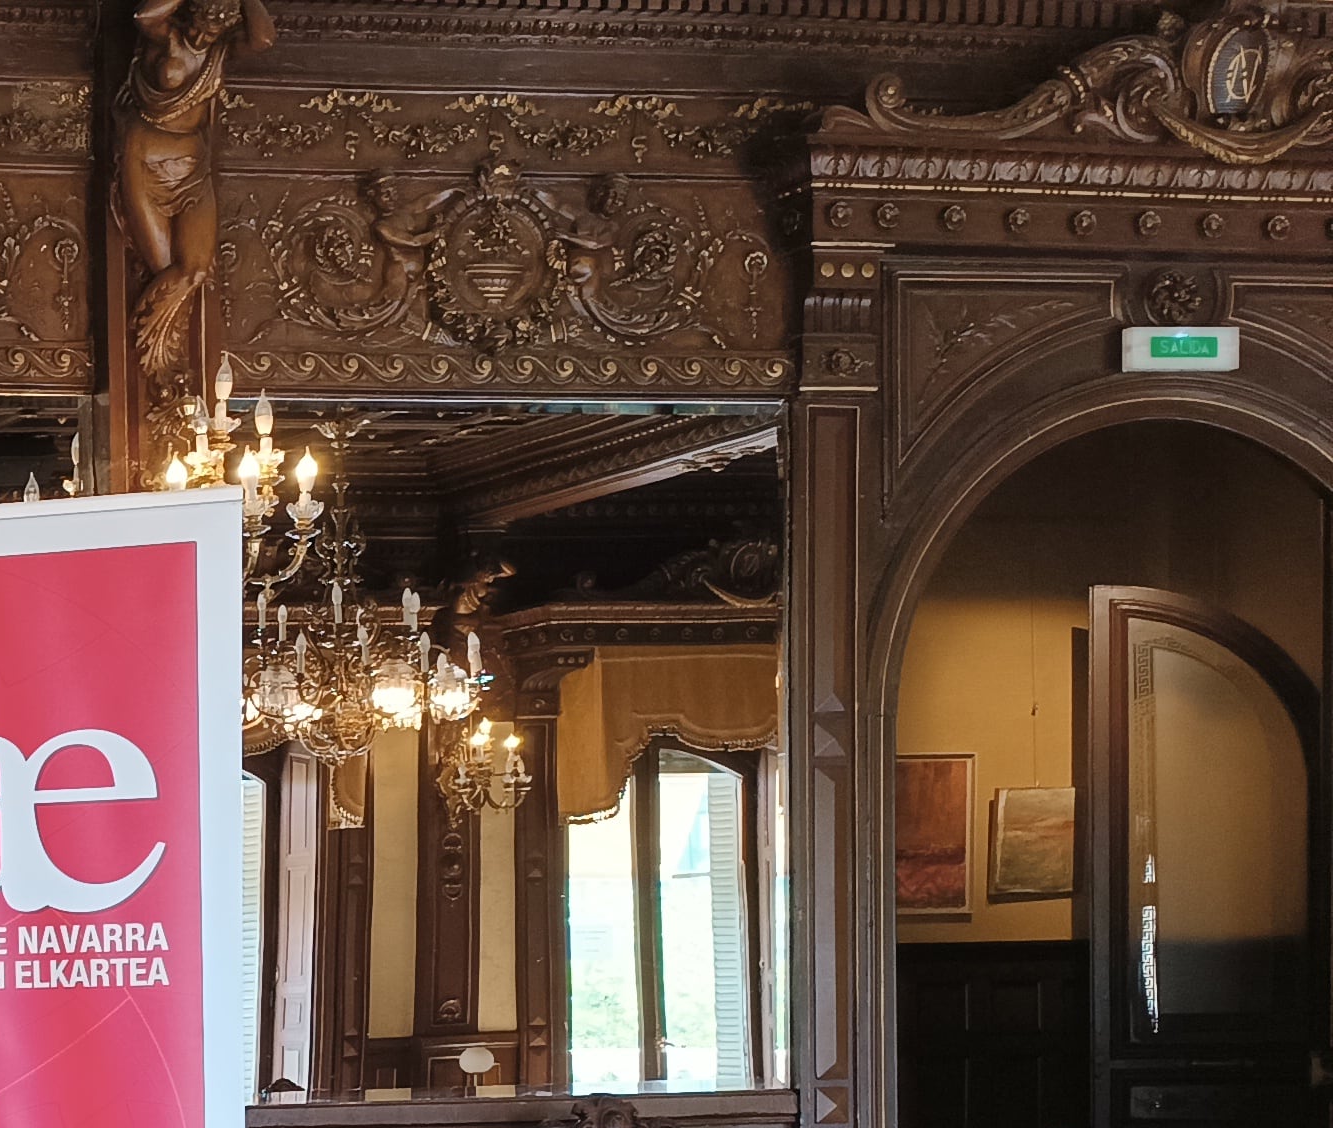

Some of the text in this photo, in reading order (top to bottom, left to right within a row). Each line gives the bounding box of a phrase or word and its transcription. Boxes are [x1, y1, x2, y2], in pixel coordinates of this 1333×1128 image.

[1159, 339, 1210, 355] SALIDA
[18, 922, 170, 955] NAVARRA
[15, 957, 170, 989] ELKARTEA
